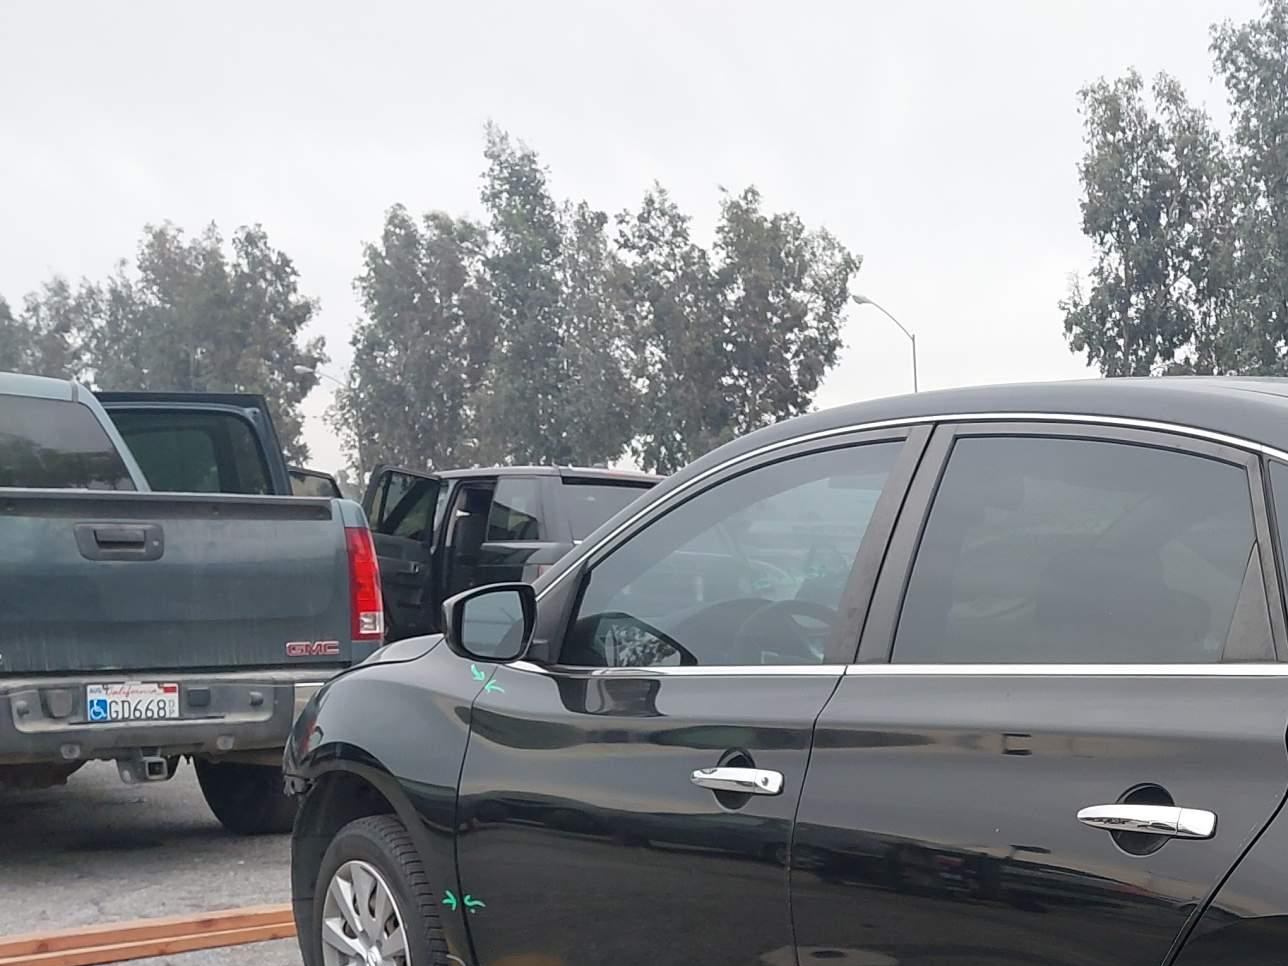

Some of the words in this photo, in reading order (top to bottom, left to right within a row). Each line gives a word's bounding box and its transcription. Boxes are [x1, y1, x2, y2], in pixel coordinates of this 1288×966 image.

[286, 640, 340, 656] GMC
[106, 684, 158, 697] California
[109, 699, 167, 720] GD668
